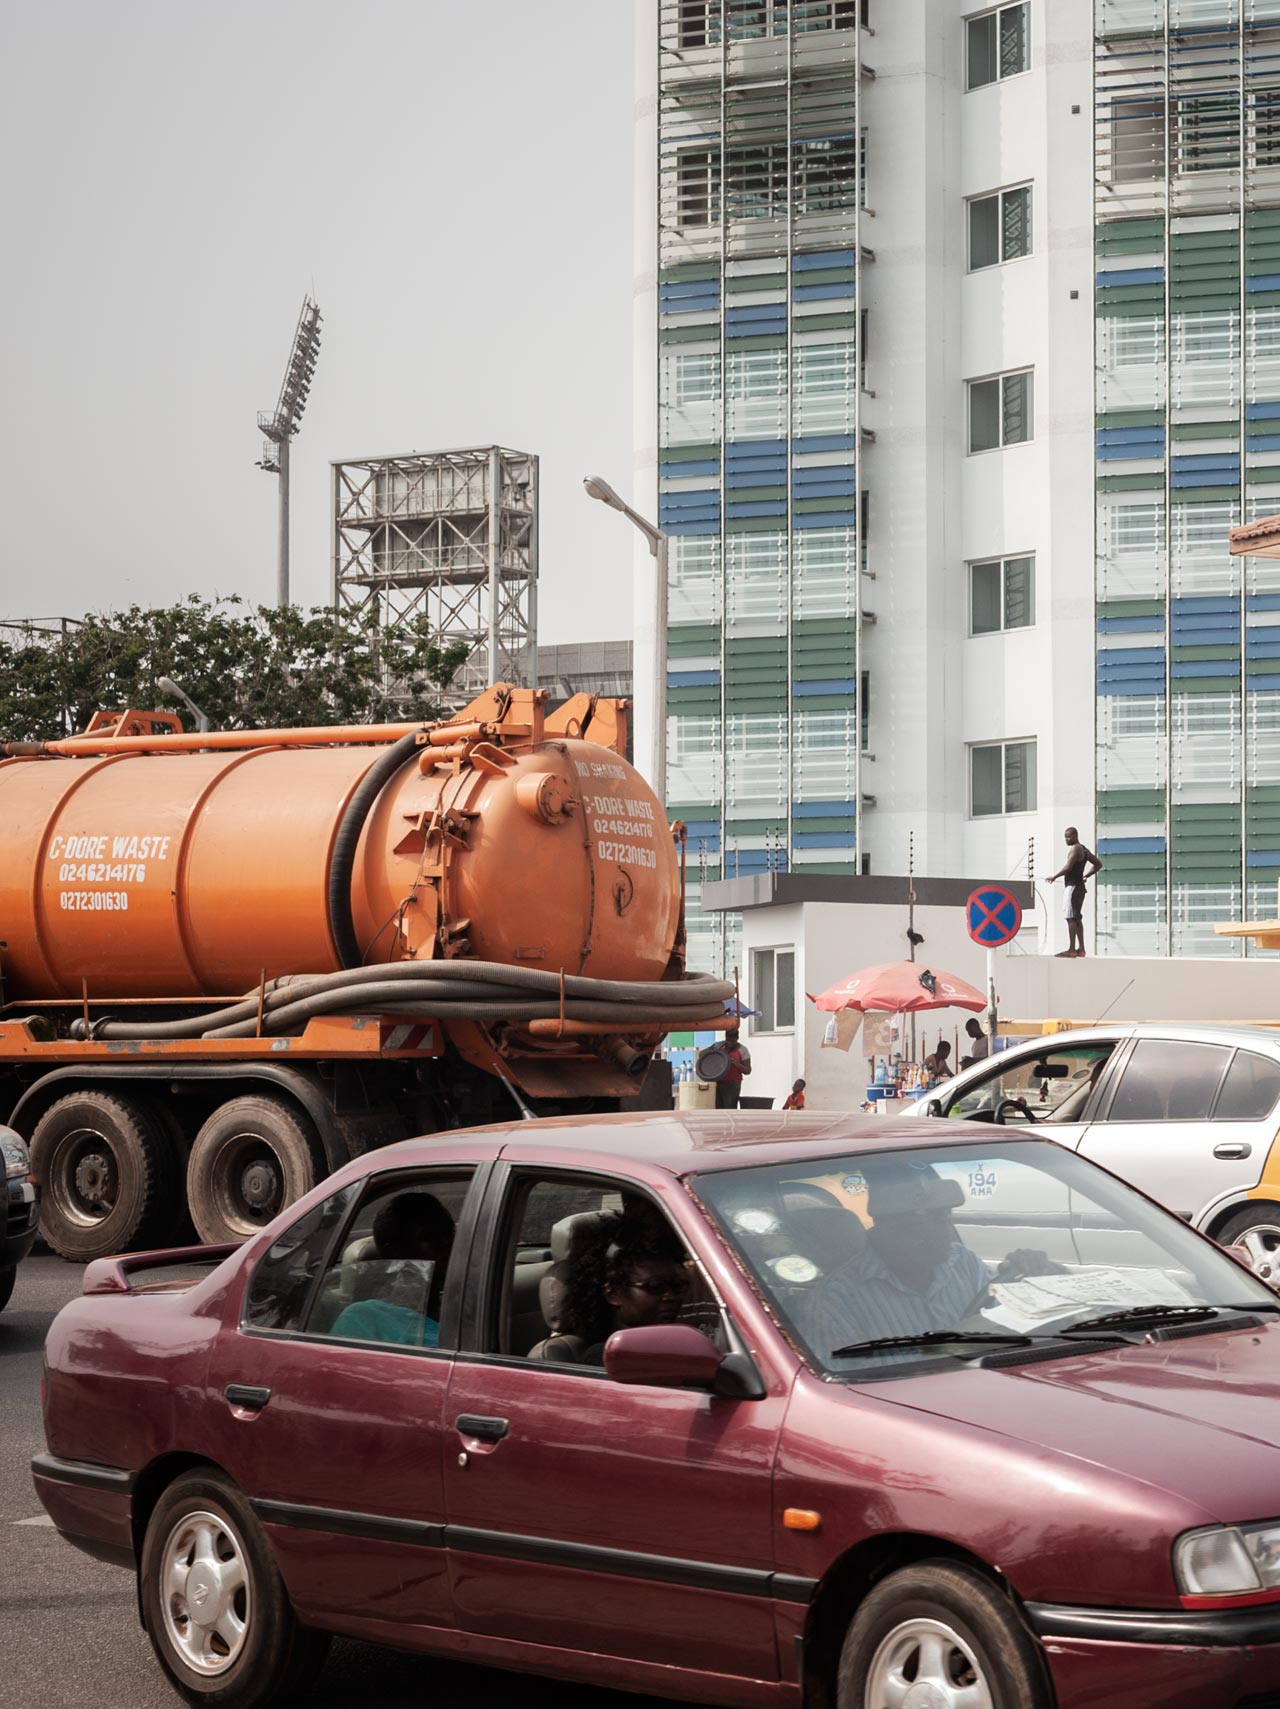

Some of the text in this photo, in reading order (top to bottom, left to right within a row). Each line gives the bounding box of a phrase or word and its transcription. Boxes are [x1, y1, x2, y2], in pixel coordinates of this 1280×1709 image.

[575, 761, 590, 777] NO
[583, 795, 654, 820] C-DORE WASTE
[593, 819, 653, 838] 0246214176
[49, 836, 171, 860] C-DORE WASTE
[598, 840, 656, 869] 0272301630
[59, 863, 146, 882] 0246214176
[60, 891, 128, 910] 0272301630
[968, 1172, 996, 1187] 194
